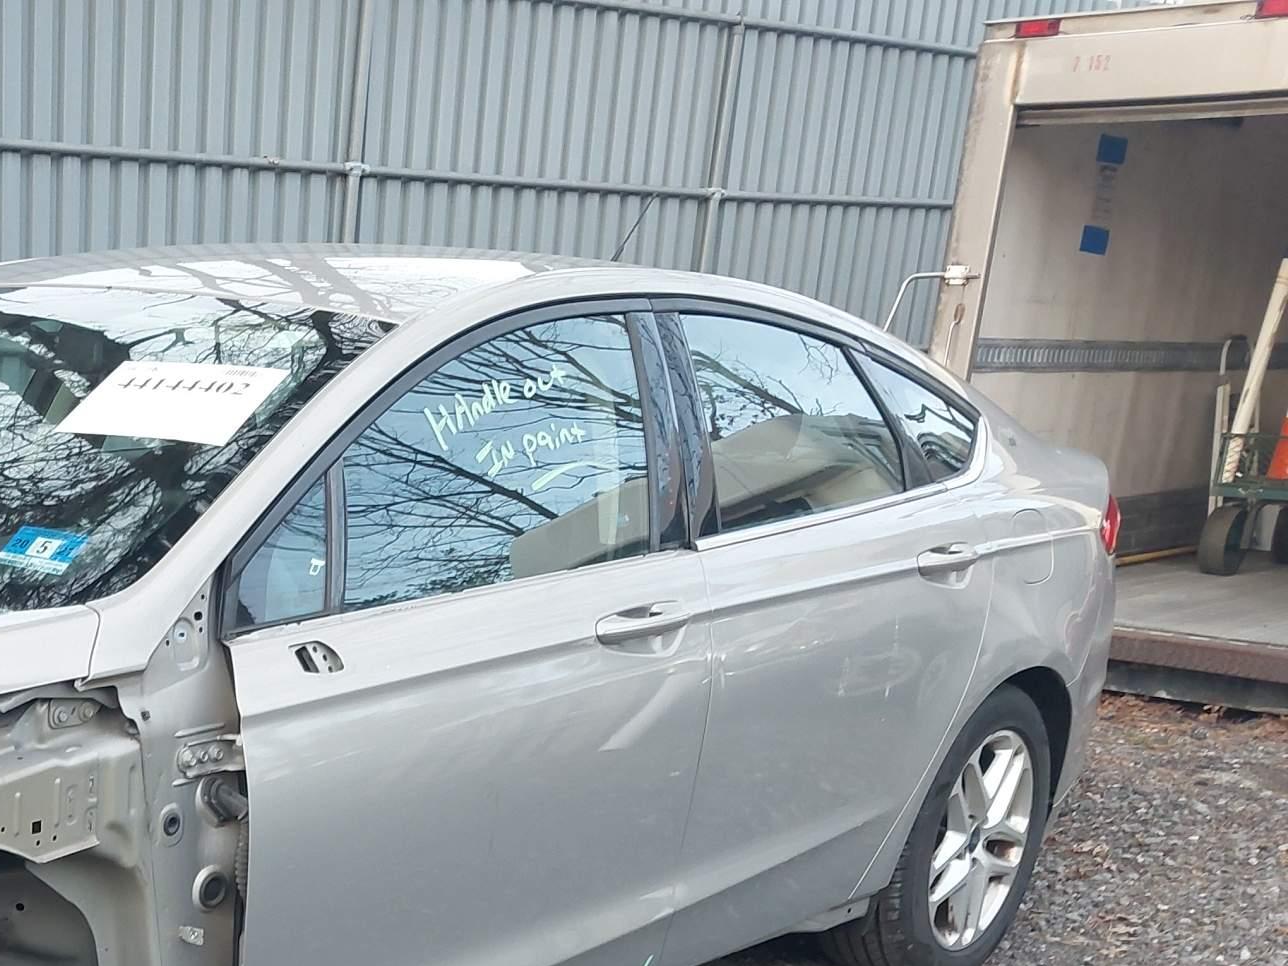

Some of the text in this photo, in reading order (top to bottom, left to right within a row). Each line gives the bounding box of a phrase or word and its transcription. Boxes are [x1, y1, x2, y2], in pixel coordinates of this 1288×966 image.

[523, 363, 566, 399] out
[523, 421, 587, 467] paint
[36, 540, 52, 553] 5
